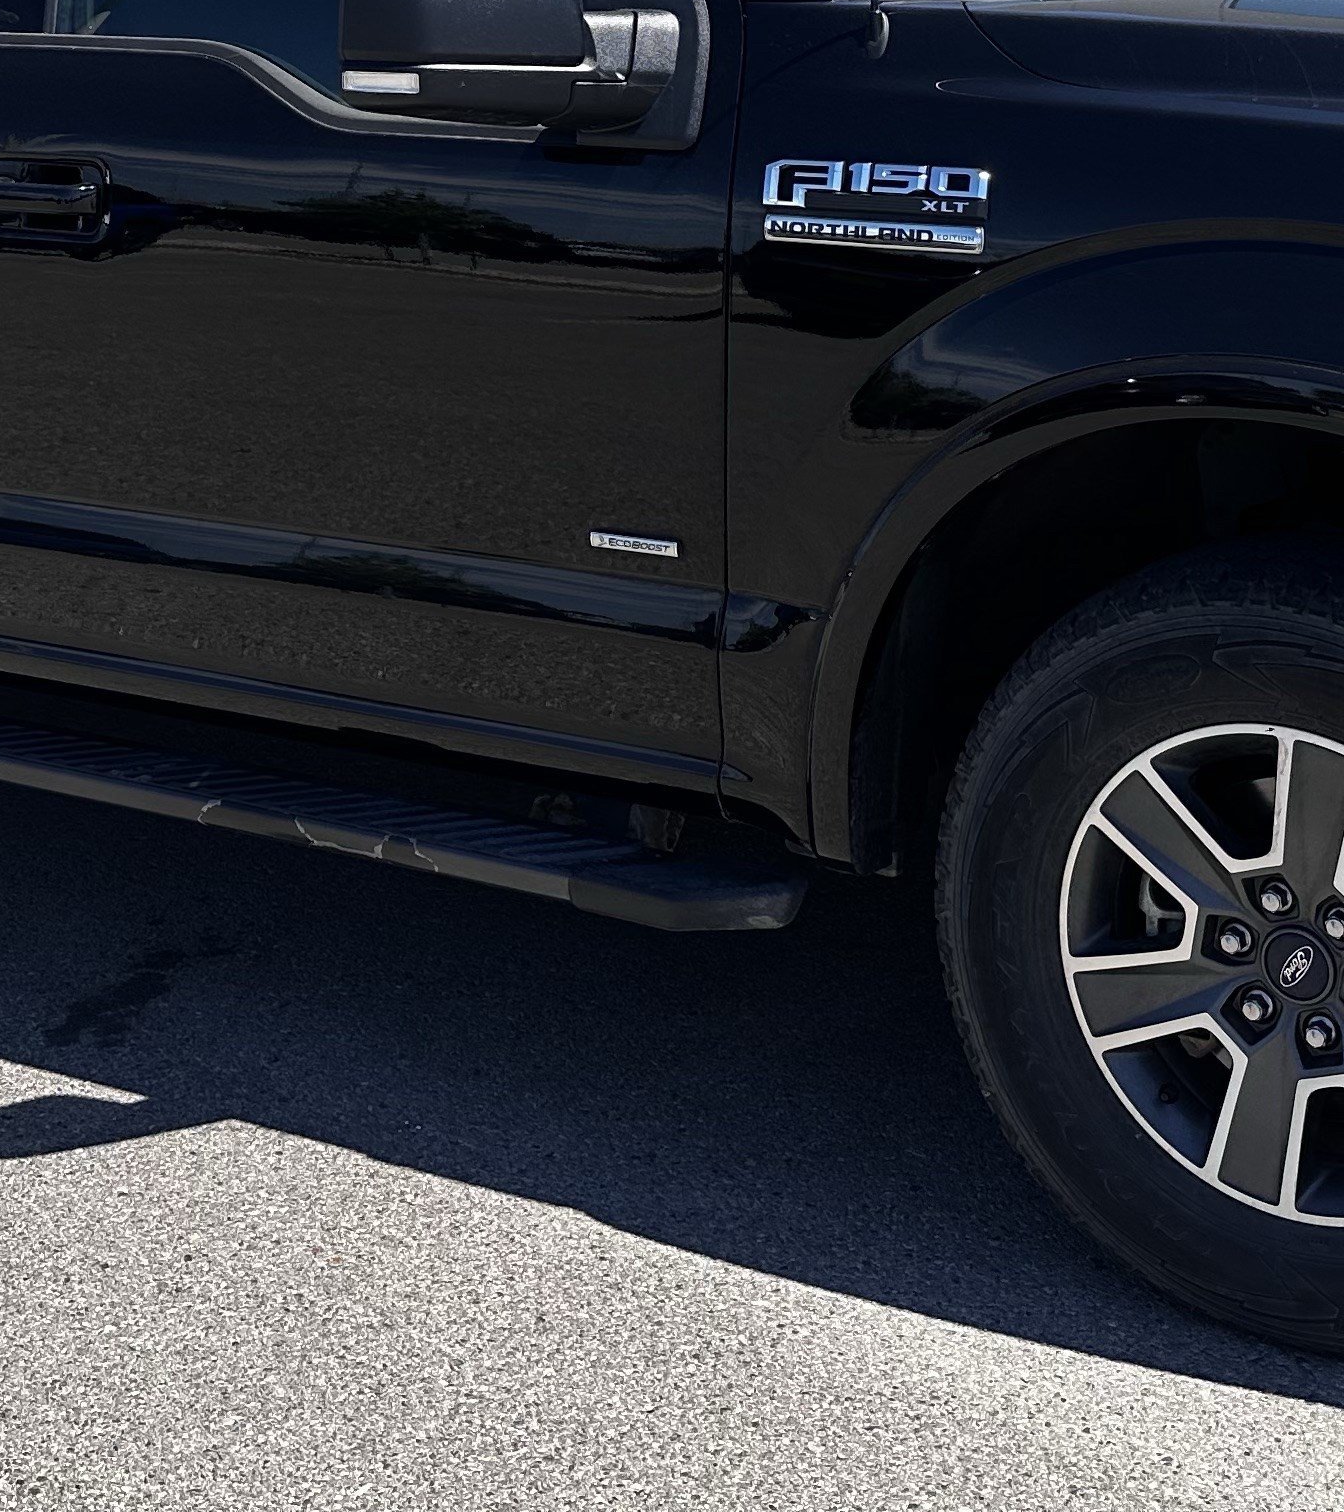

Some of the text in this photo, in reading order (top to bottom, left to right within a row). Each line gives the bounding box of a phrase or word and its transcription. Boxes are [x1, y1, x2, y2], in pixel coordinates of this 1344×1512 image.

[921, 199, 969, 213] XLT
[770, 219, 975, 243] NORTHLAND EDITION
[1283, 949, 1309, 982] Ford
